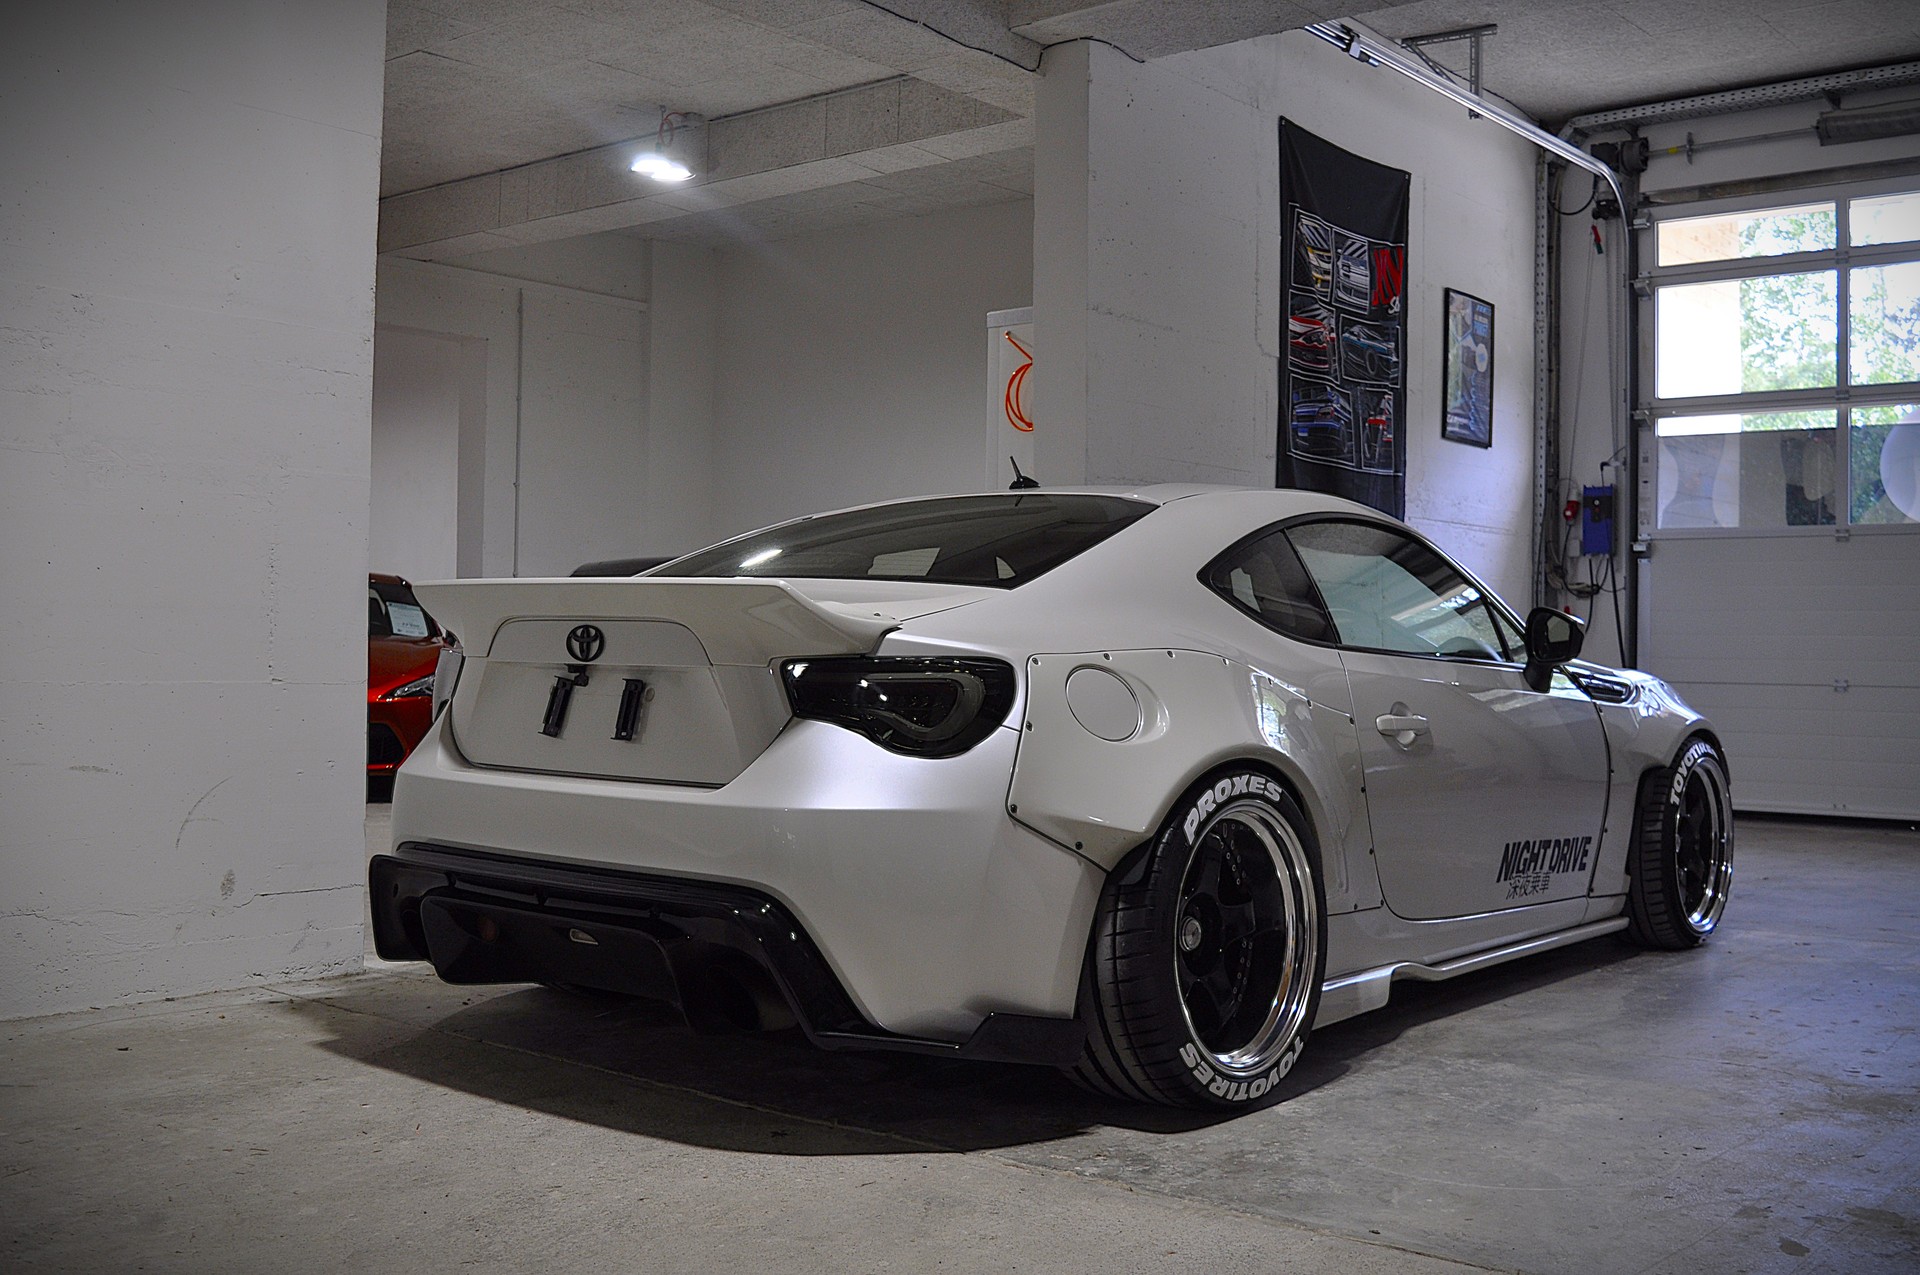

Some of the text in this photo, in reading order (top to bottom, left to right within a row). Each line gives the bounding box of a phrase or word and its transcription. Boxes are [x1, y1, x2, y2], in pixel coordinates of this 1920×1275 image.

[1184, 774, 1282, 845] PROXES
[1496, 836, 1592, 883] NIGHT DRIVE
